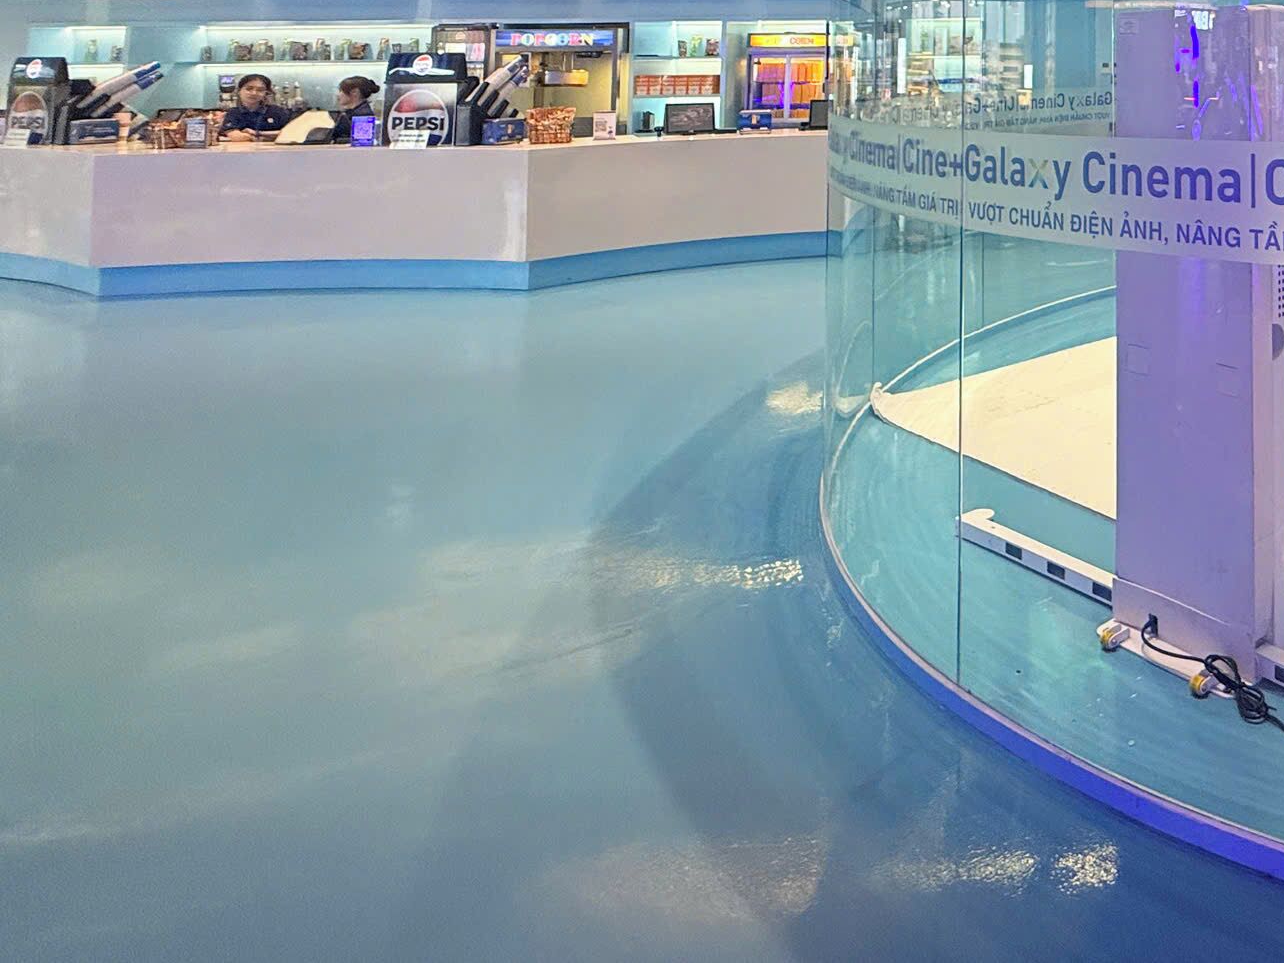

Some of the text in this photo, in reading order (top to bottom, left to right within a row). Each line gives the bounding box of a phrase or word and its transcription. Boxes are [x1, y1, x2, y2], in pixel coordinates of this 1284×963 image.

[510, 32, 595, 46] POPCORN
[391, 116, 445, 132] PEPSI
[848, 130, 896, 170] Cinema
[964, 143, 1072, 202] Galaxy
[918, 189, 937, 213] GIÁ
[939, 197, 959, 220] TRỊ
[968, 201, 1004, 224] VƯỢT
[1009, 201, 1065, 231] CHUẨN
[1070, 209, 1113, 237] ĐIỆN
[1119, 210, 1168, 245] ẢNH,
[1176, 219, 1242, 248] NÂNG
